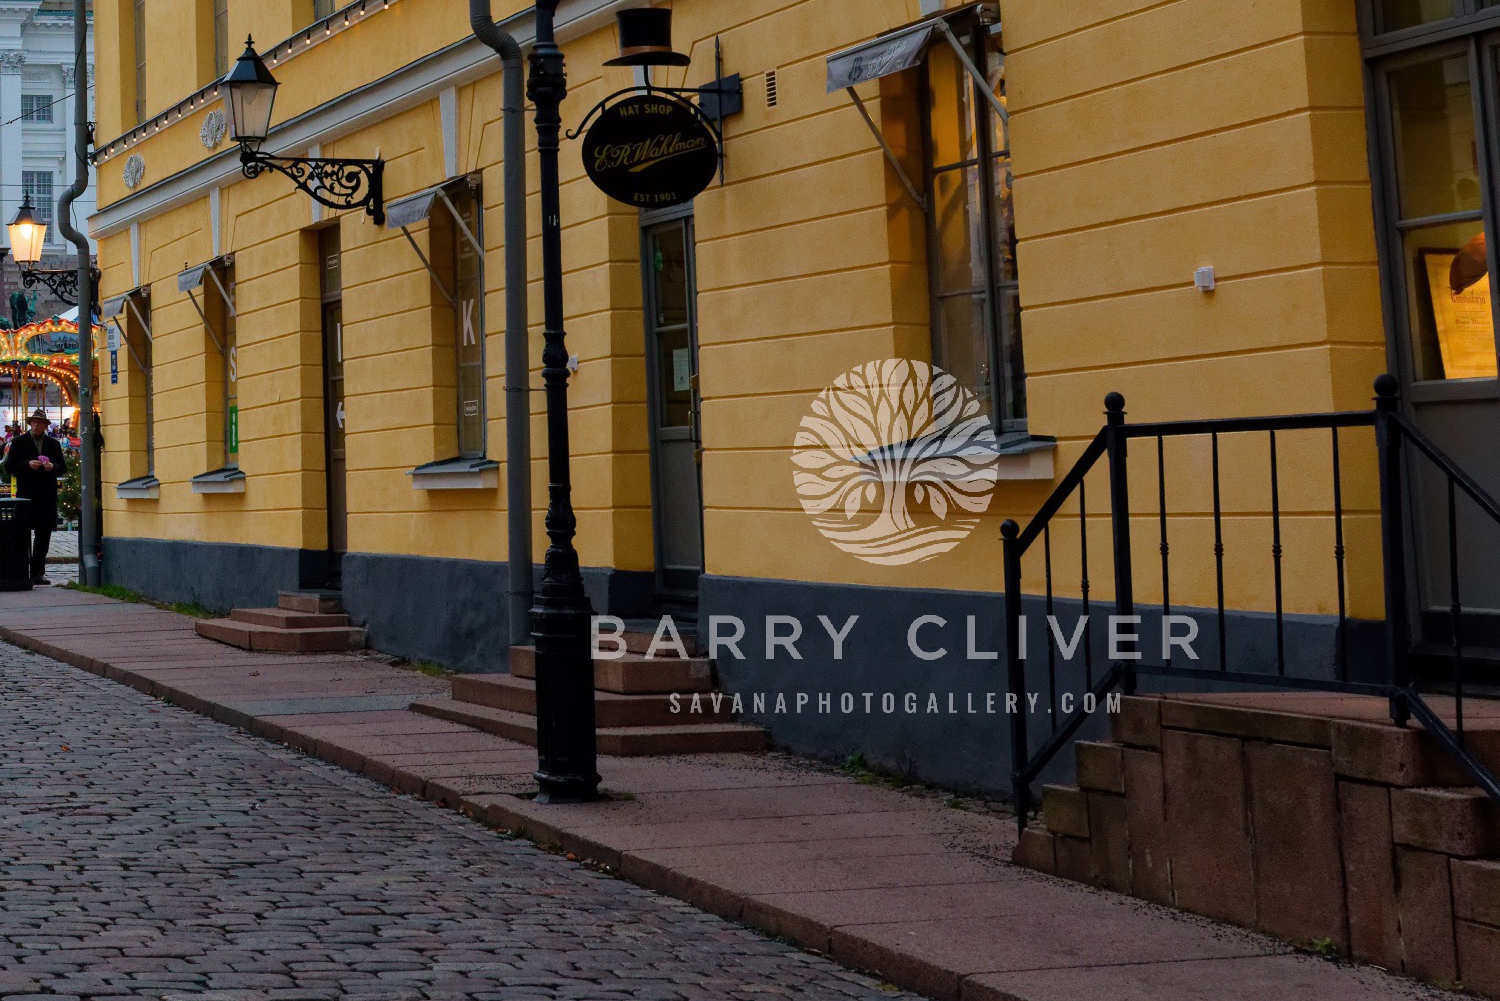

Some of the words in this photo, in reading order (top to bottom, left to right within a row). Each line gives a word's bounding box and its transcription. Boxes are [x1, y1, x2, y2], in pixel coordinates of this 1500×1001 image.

[619, 104, 640, 117] HAT
[644, 103, 673, 115] SHOP
[634, 193, 650, 202] EST
[654, 192, 677, 202] 1901
